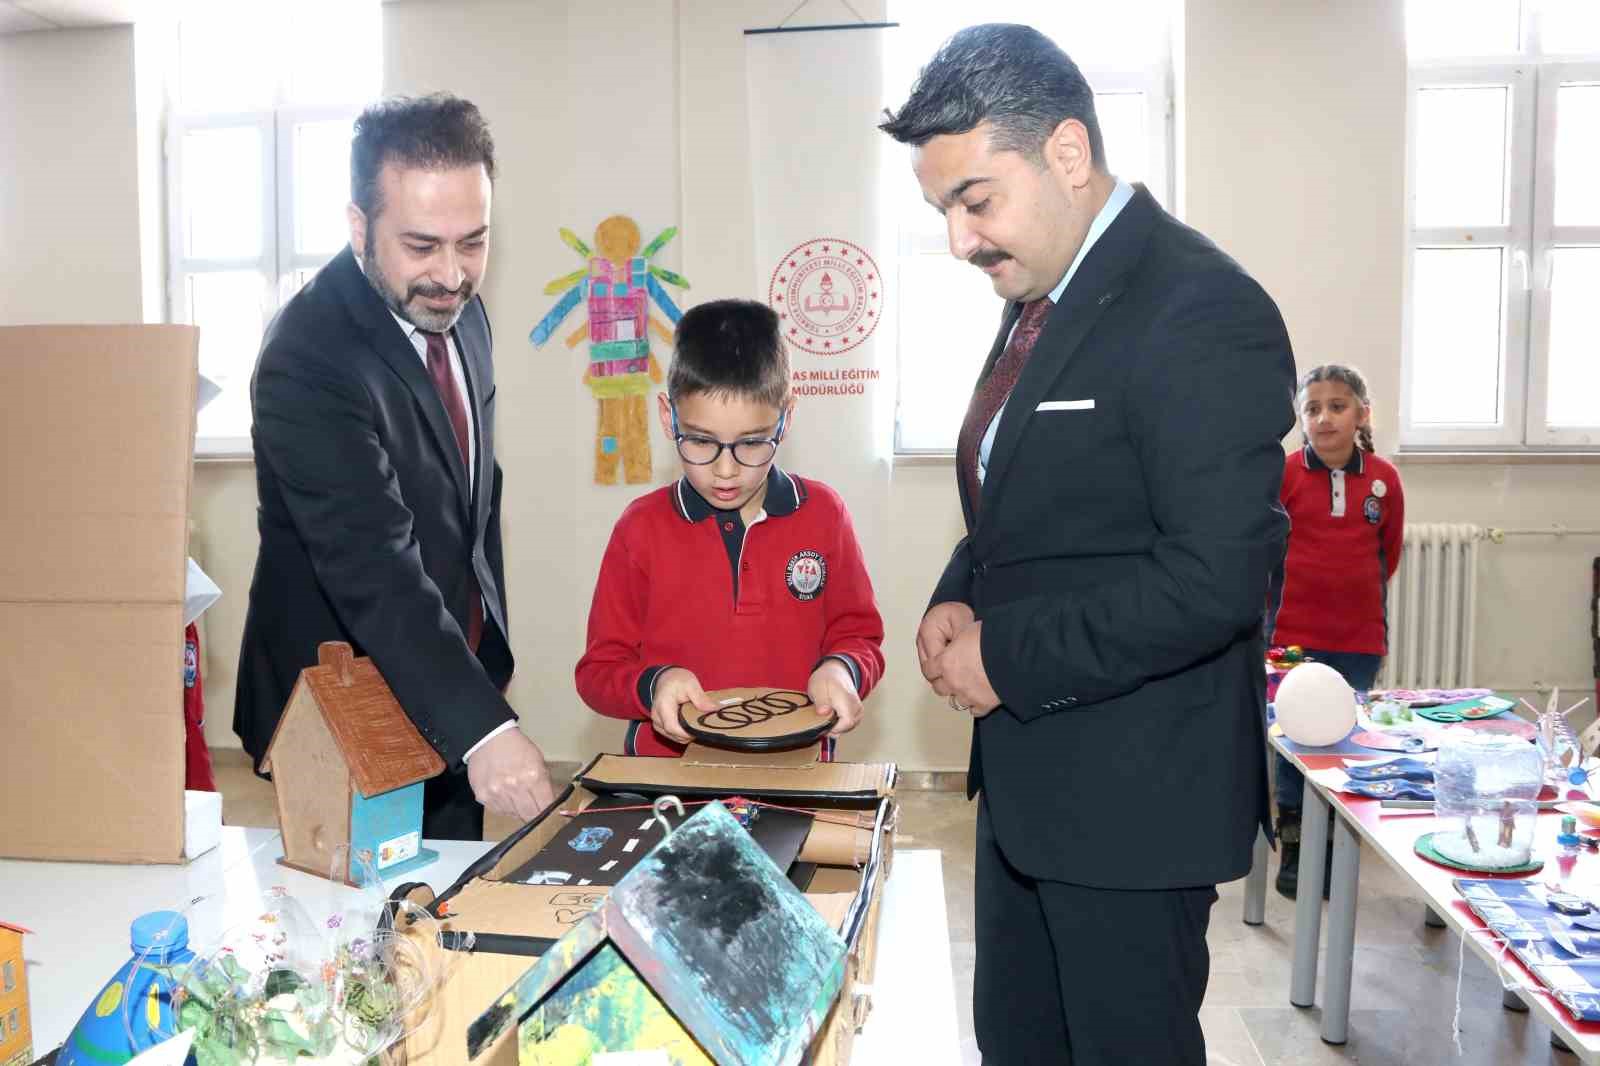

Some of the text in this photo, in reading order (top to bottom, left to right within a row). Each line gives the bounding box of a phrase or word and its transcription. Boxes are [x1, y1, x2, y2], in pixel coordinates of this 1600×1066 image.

[792, 367, 880, 381] AS MİLLİ EĞİTİM
[791, 383, 864, 396] MÜDÜRLÜĞÜ
